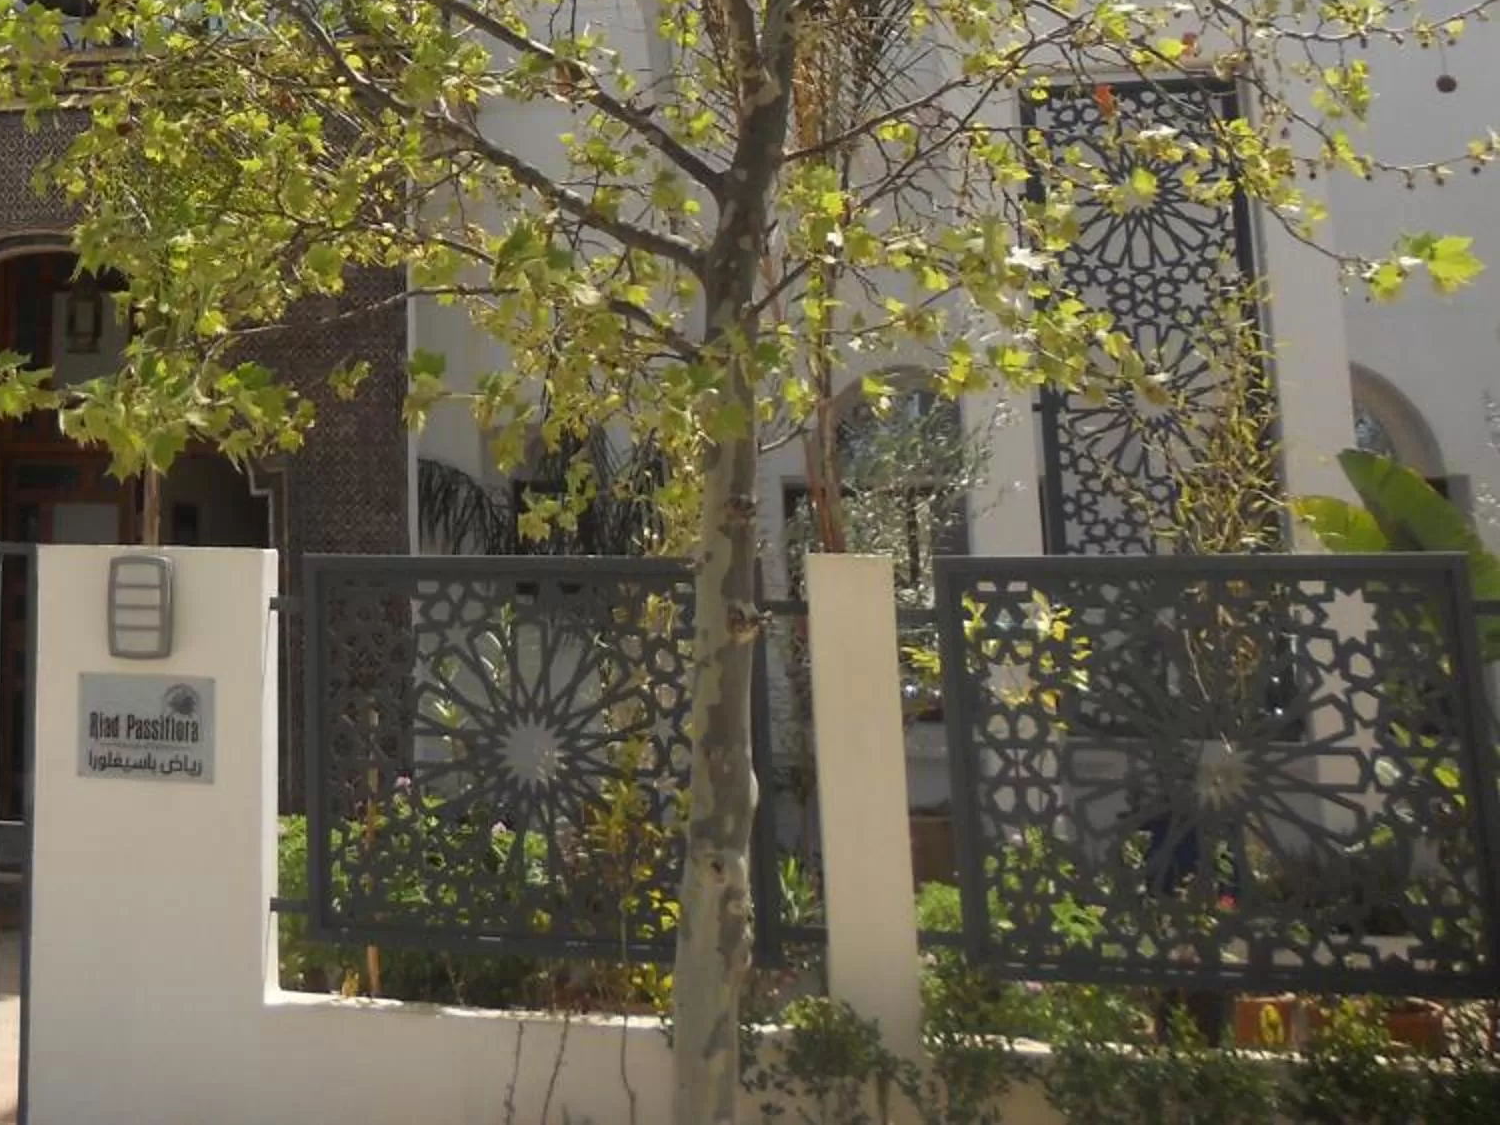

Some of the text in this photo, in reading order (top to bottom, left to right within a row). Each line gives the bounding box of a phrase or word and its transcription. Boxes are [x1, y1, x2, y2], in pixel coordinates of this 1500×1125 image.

[89, 711, 199, 743] Riad Passiflora
[159, 753, 203, 777] رياض
